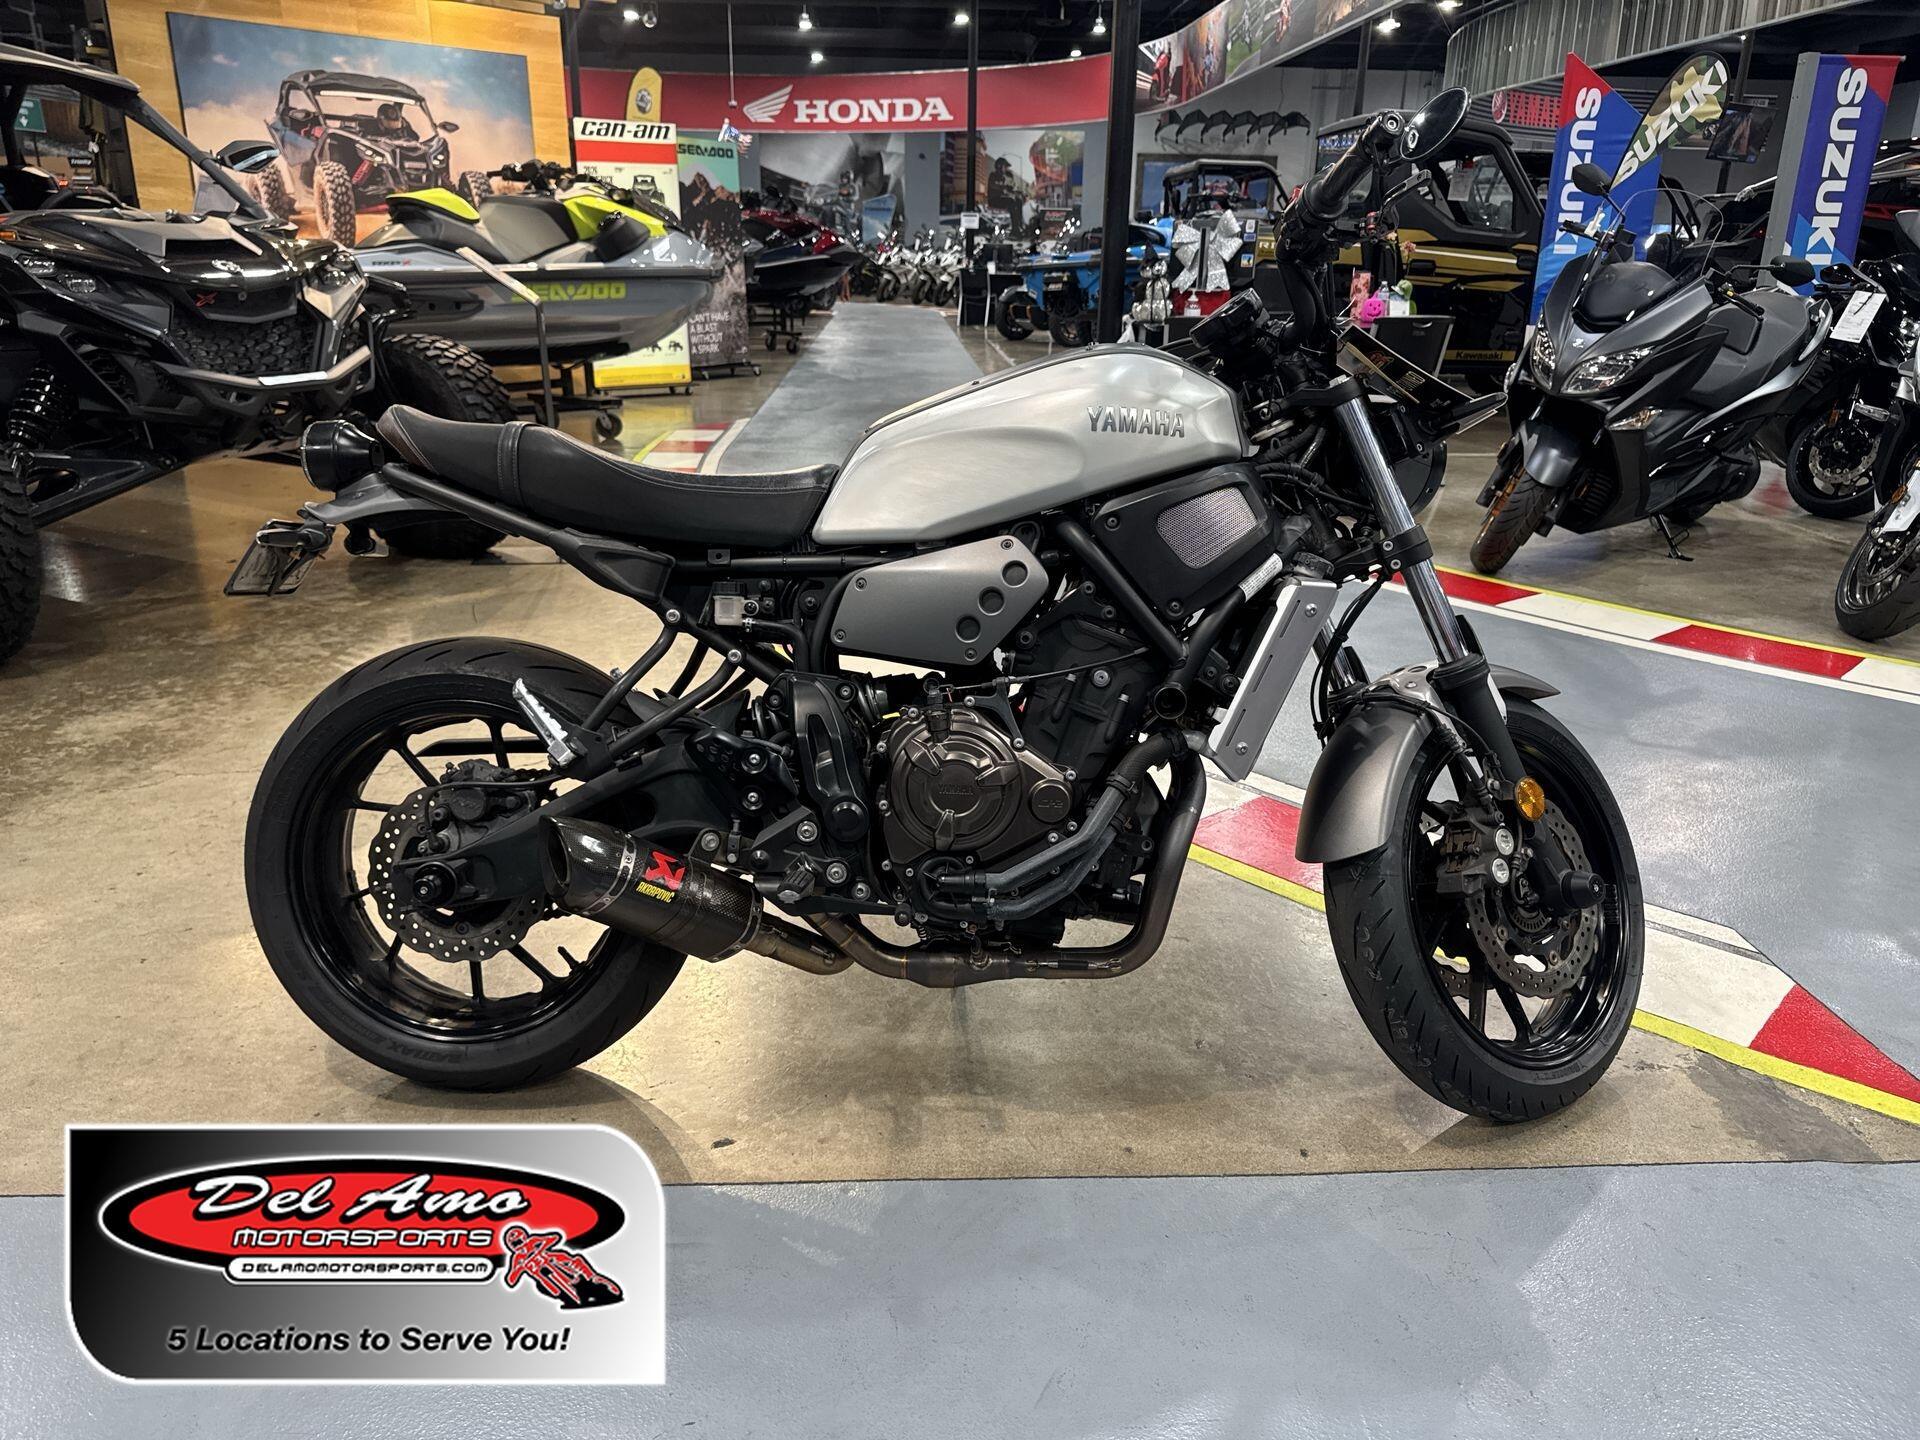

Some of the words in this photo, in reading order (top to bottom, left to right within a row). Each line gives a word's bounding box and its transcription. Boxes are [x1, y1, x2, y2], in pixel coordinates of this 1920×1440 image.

[793, 97, 954, 123] HONDA
[580, 121, 672, 140] can-am
[1612, 60, 1728, 182] SUZUKI
[1804, 67, 1868, 266] SUZUKI
[711, 310, 730, 321] HAVE
[696, 323, 718, 333] BLAST
[690, 332, 723, 344] WITHOUT
[1456, 351, 1504, 360] Kawasaki
[1087, 406, 1186, 438] YAMAHA
